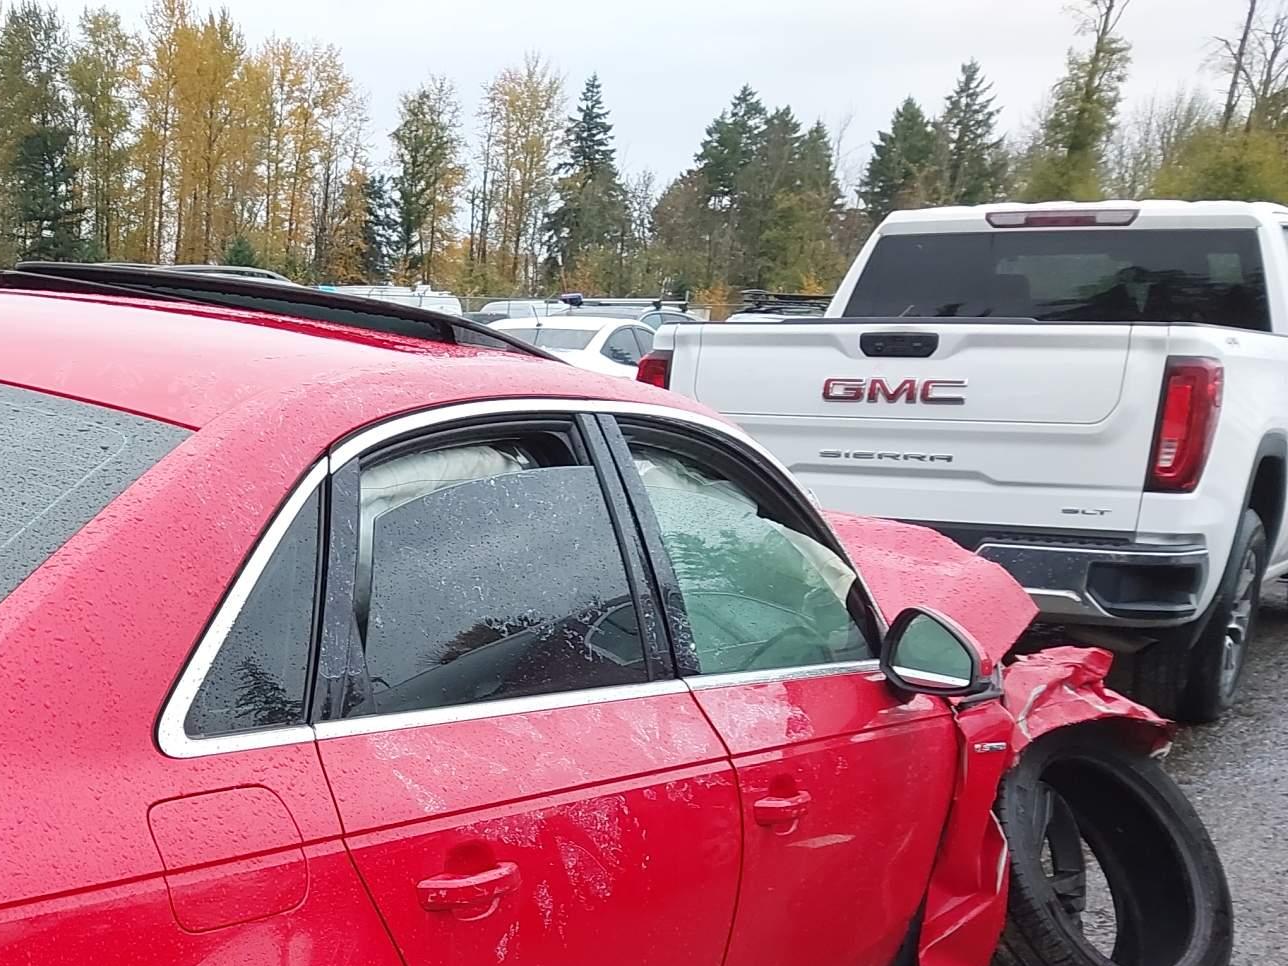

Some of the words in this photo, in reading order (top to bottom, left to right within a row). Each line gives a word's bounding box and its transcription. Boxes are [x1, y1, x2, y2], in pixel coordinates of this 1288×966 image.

[822, 376, 967, 405] GMC
[818, 450, 954, 463] SIERRA
[1061, 508, 1112, 516] SLT
